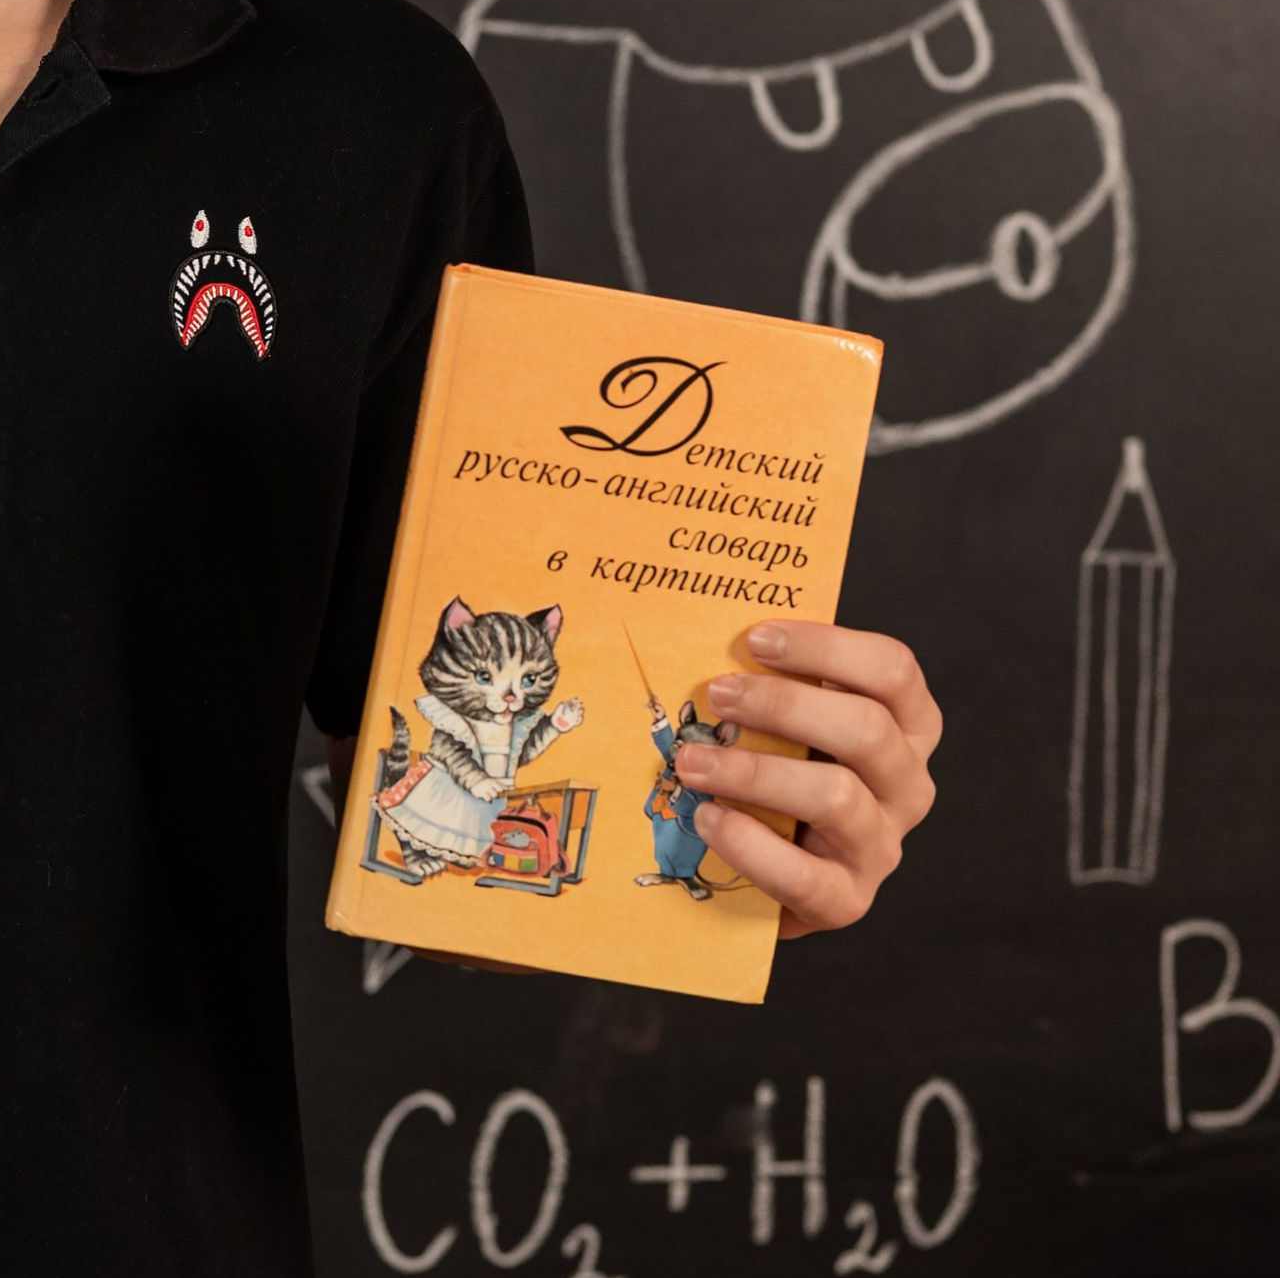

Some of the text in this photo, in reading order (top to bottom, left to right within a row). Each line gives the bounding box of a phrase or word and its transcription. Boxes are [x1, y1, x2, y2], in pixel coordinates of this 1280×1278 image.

[558, 355, 827, 485] Детский
[452, 444, 819, 527] русско-английский
[546, 548, 805, 611] в картинках
[667, 522, 810, 571] словарь
